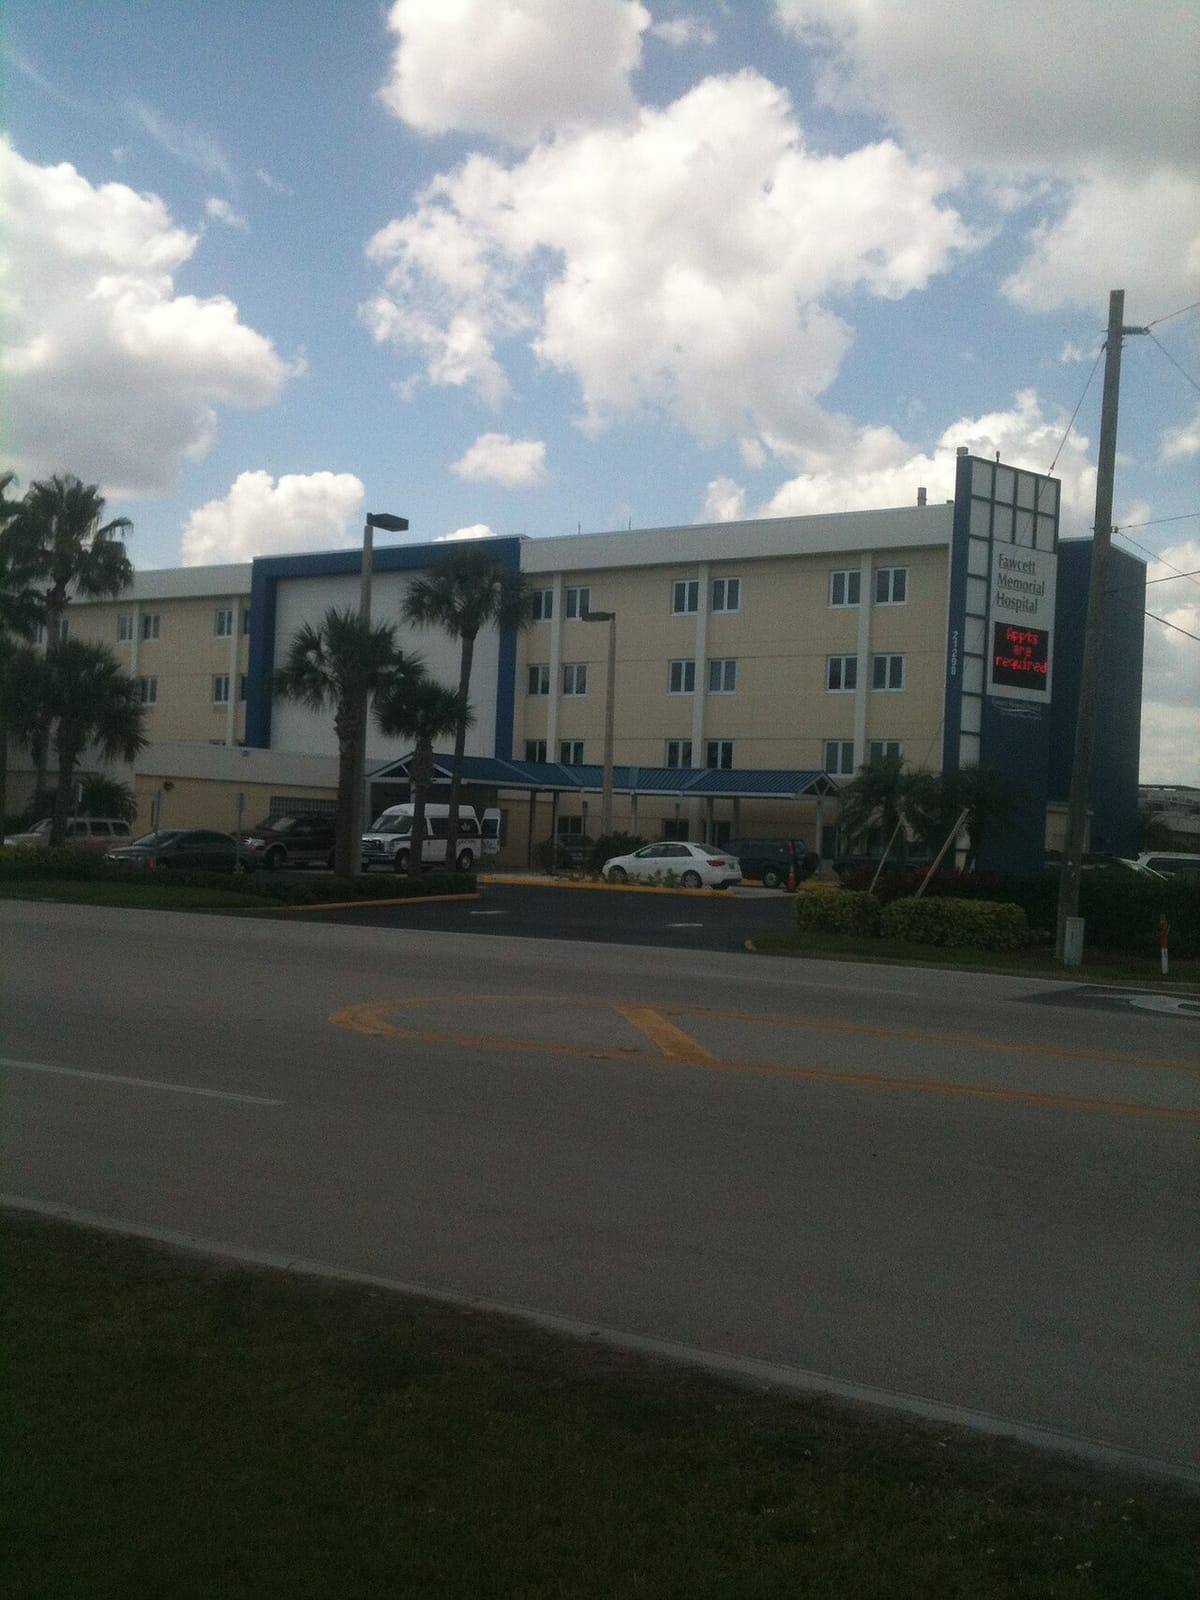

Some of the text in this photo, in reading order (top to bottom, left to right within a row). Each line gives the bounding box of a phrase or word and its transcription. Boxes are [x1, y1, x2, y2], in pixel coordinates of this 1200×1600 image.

[999, 553, 1036, 575] Fawcett
[998, 572, 1045, 596] Memorial
[996, 590, 1038, 614] Hospital
[995, 656, 1048, 674] required
